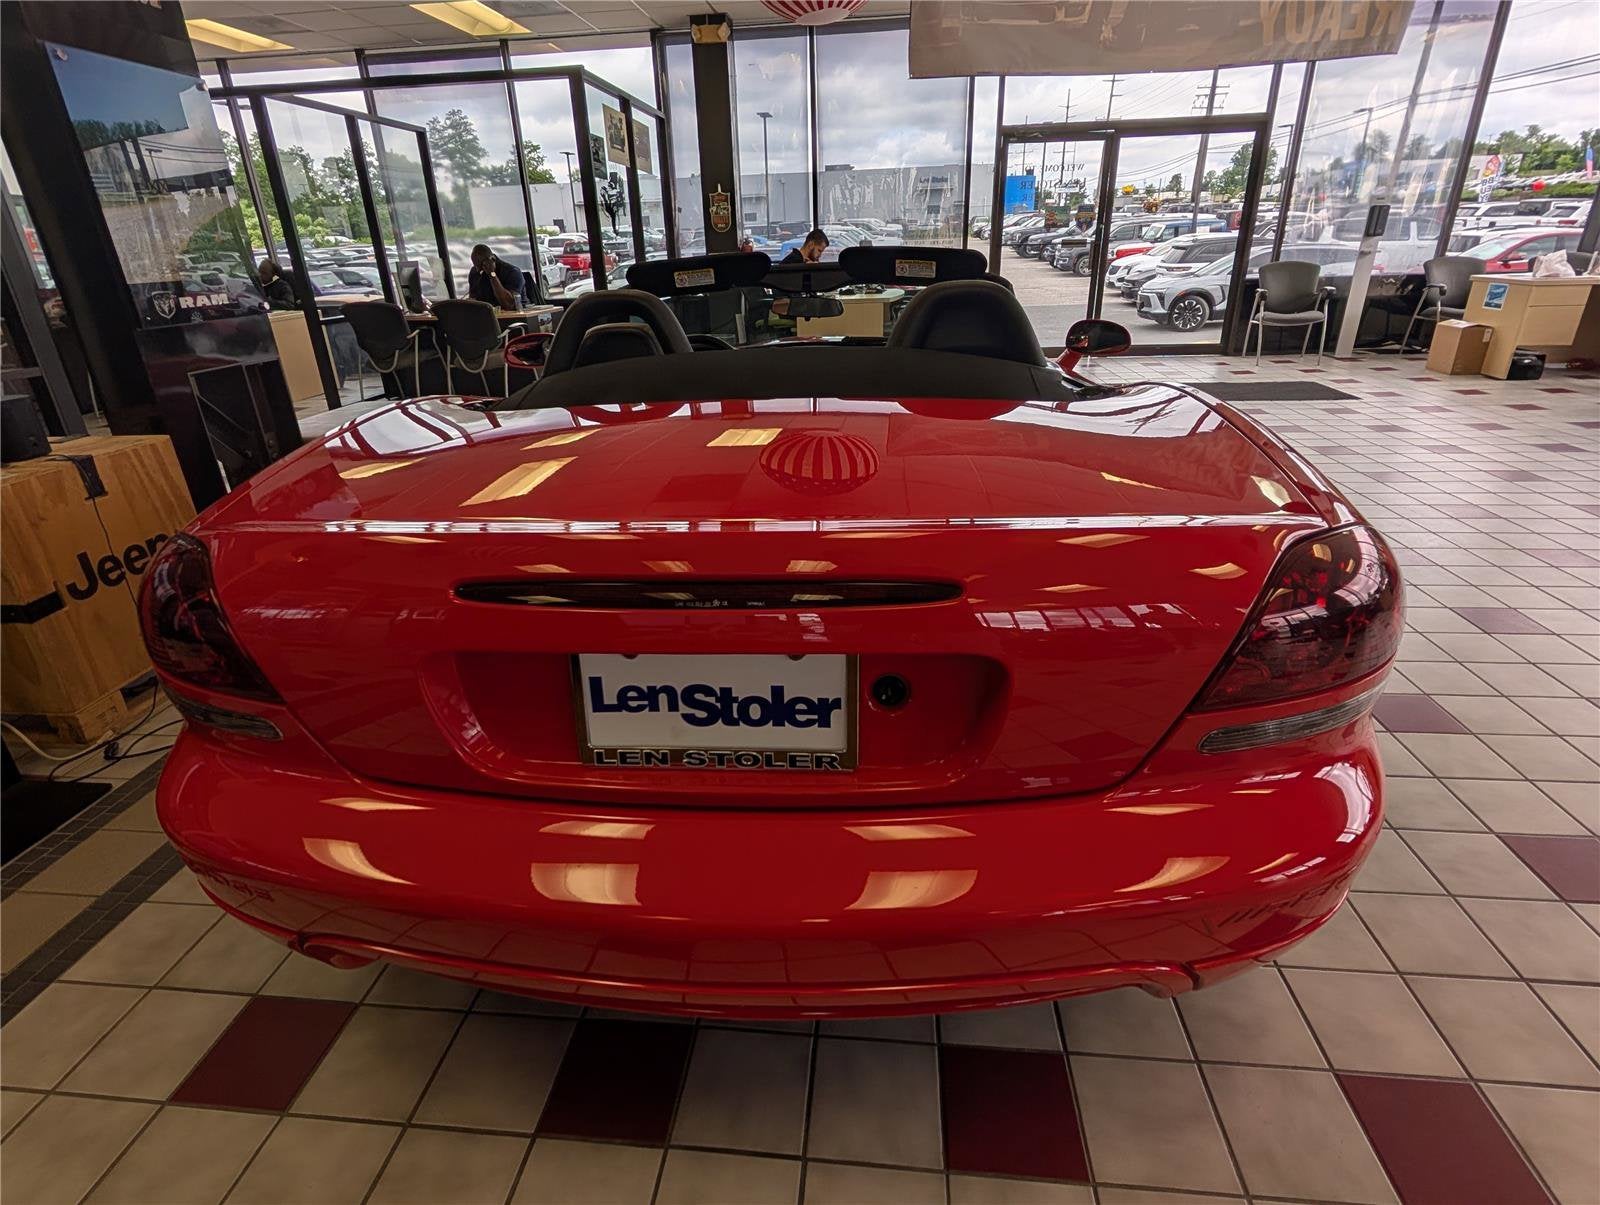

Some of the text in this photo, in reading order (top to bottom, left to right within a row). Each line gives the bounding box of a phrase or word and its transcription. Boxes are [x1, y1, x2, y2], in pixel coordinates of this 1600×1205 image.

[179, 293, 229, 309] RAM
[594, 749, 843, 770] LEN STOLER
